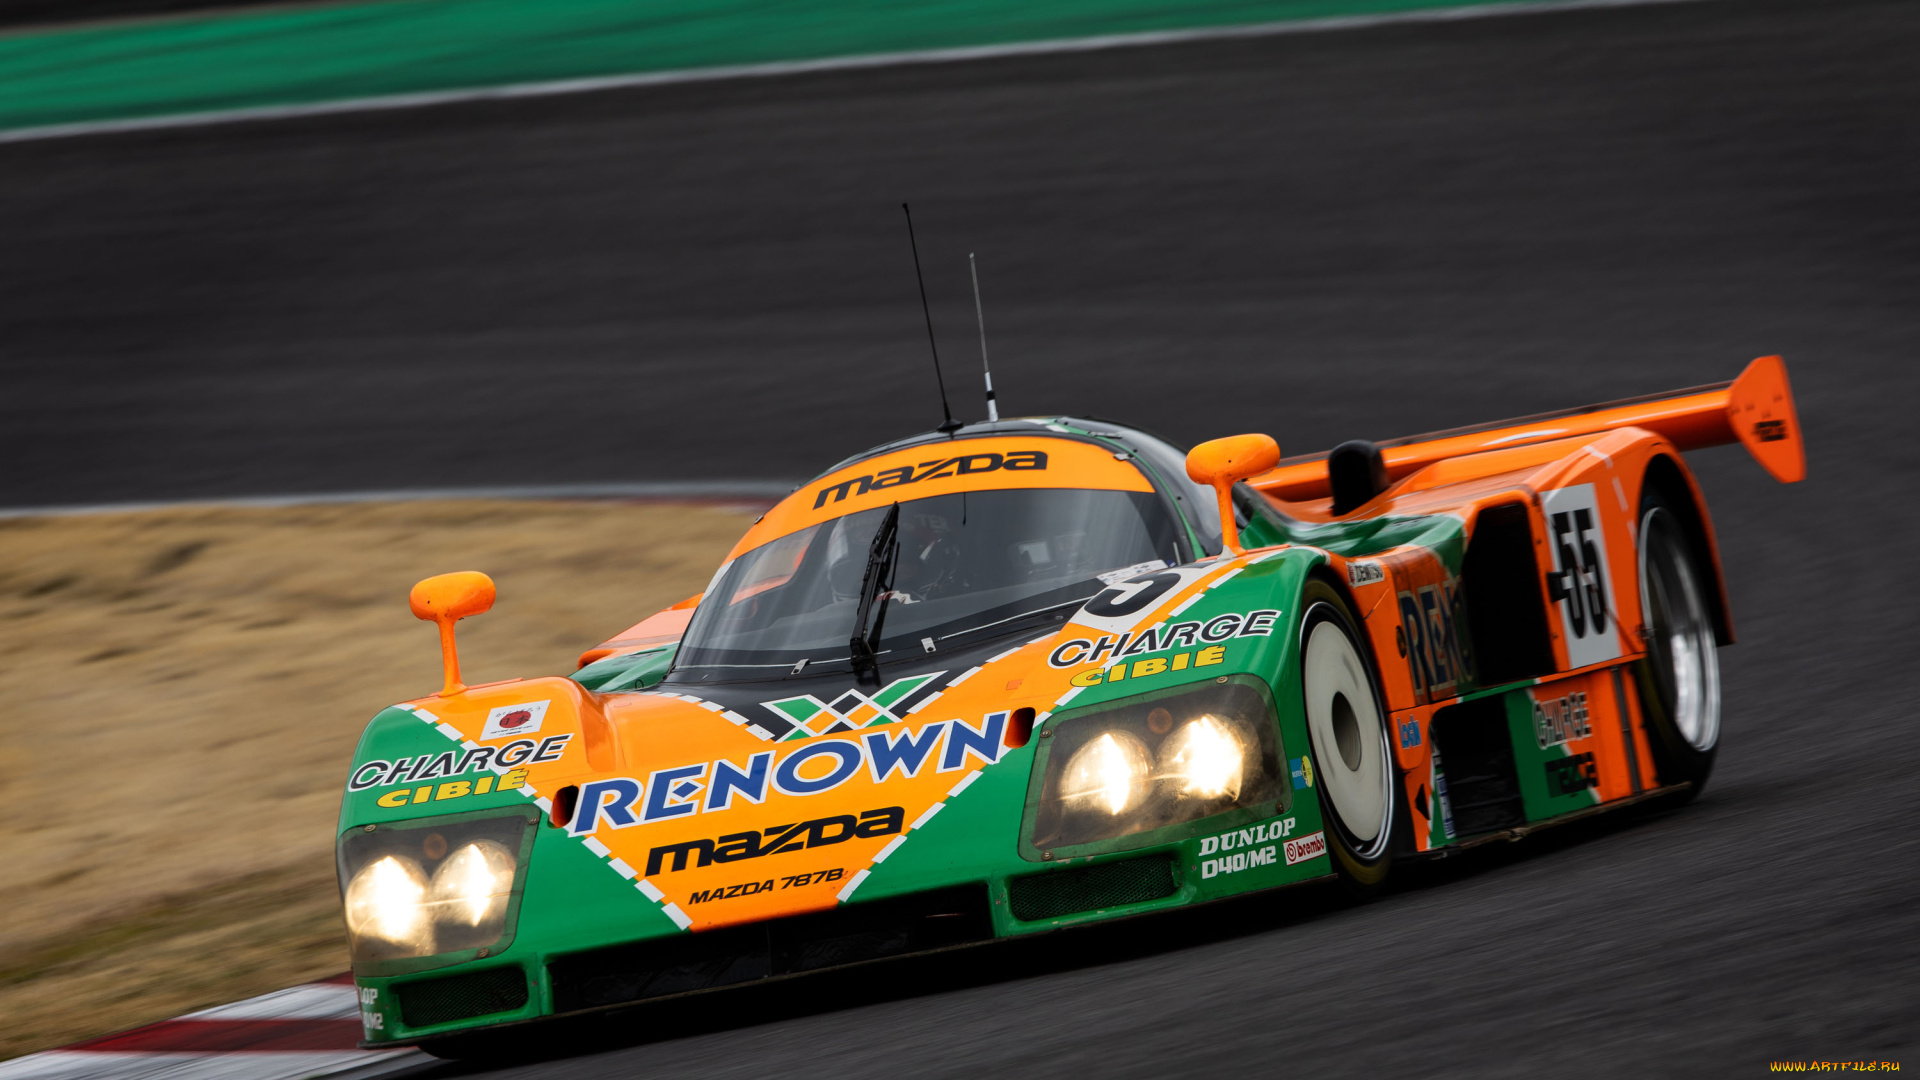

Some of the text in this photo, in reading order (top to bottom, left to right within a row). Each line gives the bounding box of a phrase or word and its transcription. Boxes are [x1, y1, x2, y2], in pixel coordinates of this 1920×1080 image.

[812, 450, 1048, 510] mazda
[1551, 507, 1608, 639] 55
[1047, 608, 1282, 670] CHARGE
[1070, 644, 1227, 688] CIBIÉ
[347, 732, 575, 793] CHARGE
[376, 767, 529, 808] CIBIÉ
[567, 710, 1011, 838] RENOWN
[645, 806, 905, 877] mazda
[1198, 817, 1296, 857] DUNLOP
[1202, 845, 1277, 880] D40/M2
[1297, 835, 1326, 859] brembo
[688, 867, 845, 905] MAZDA 787B
